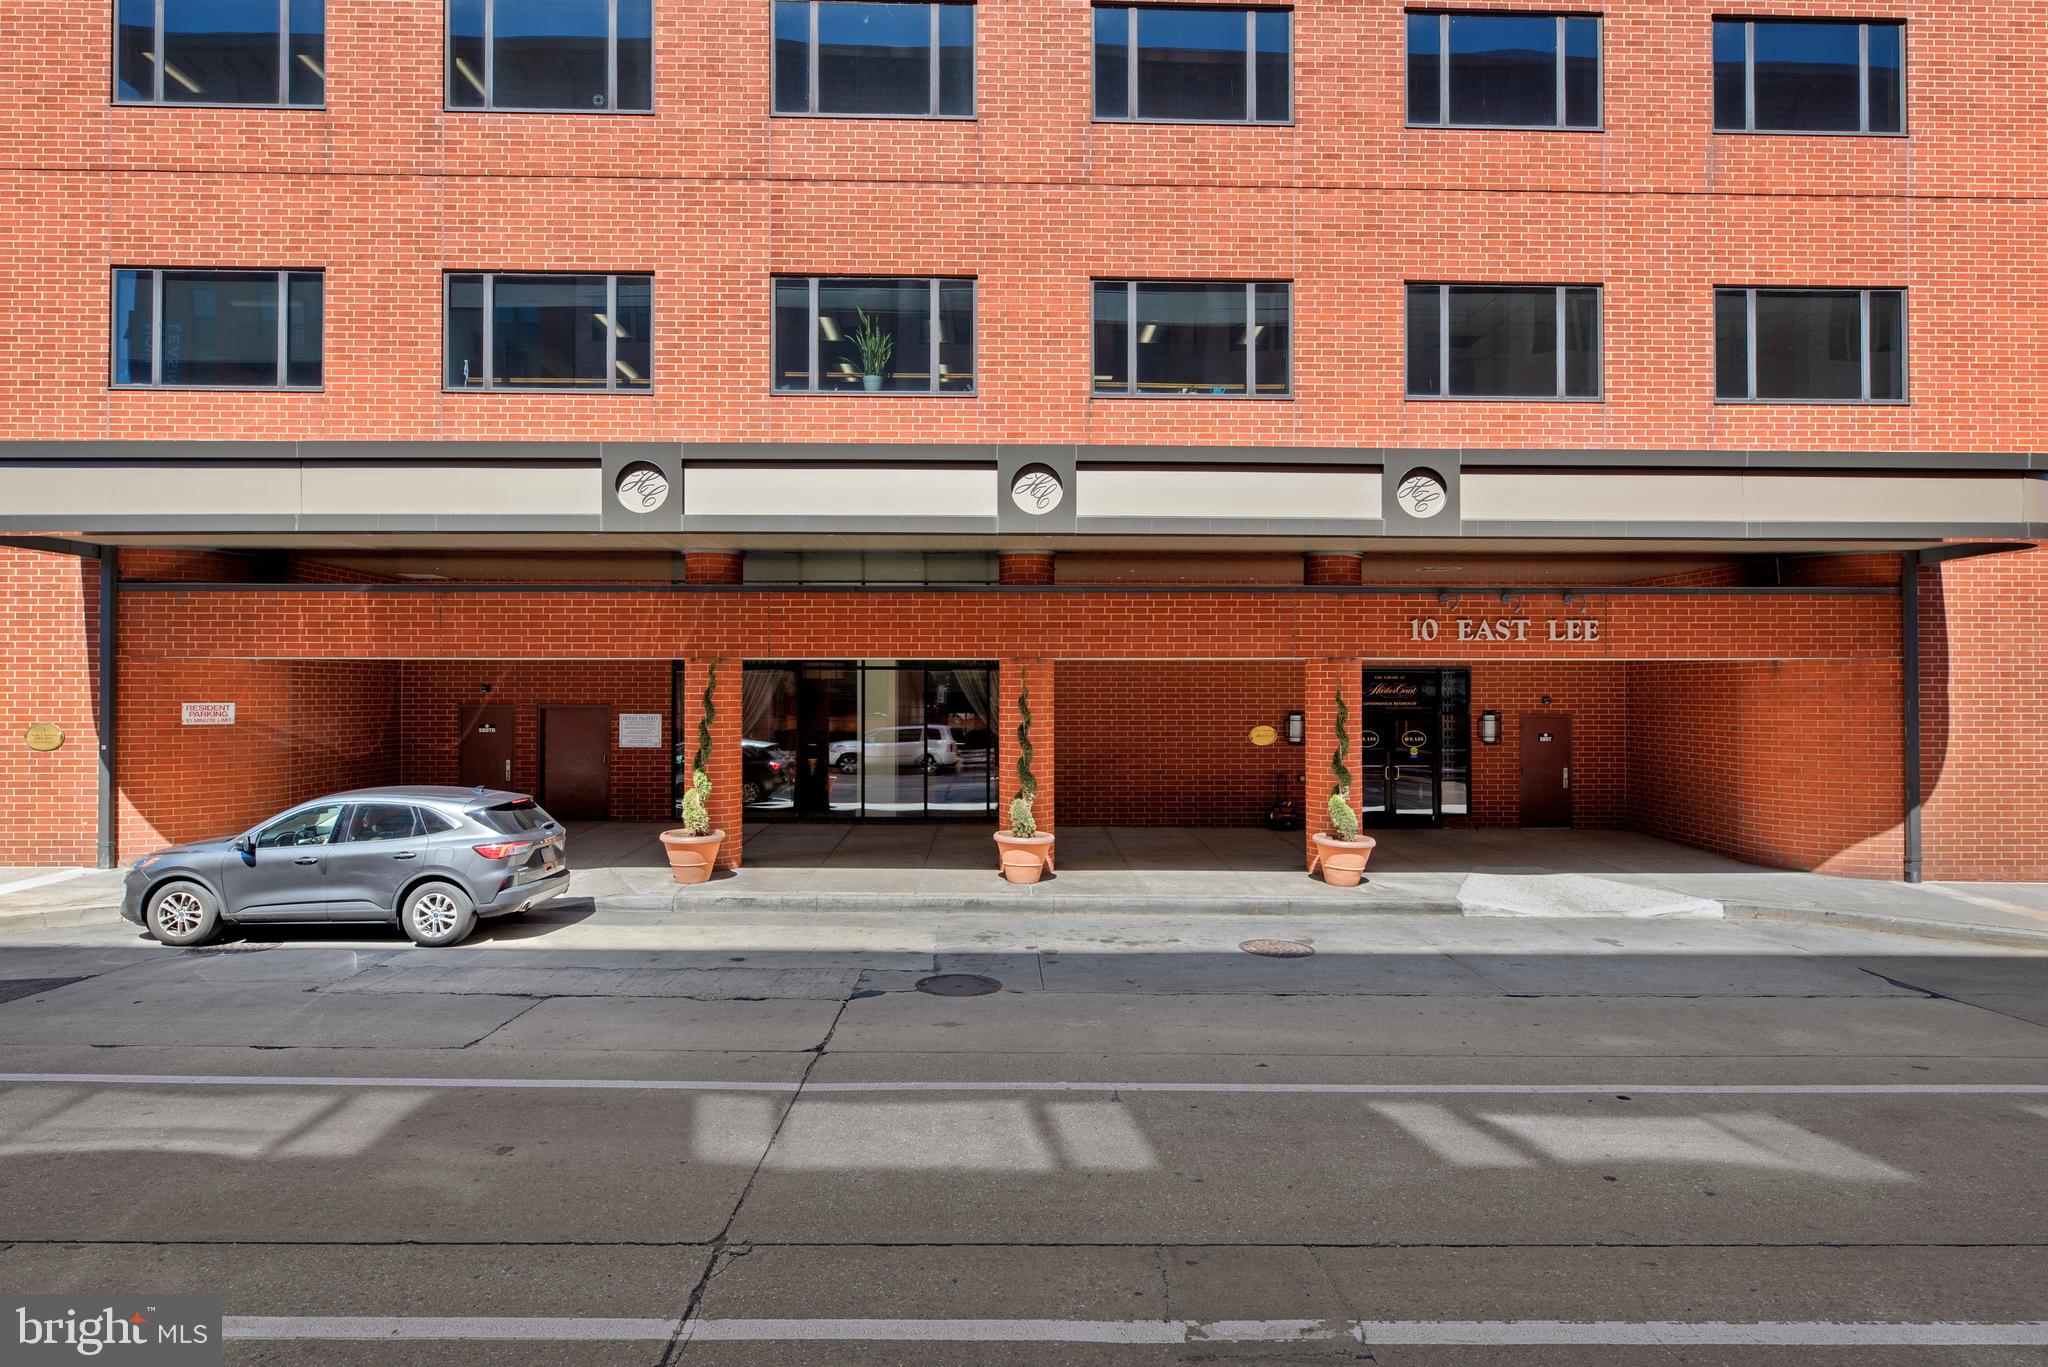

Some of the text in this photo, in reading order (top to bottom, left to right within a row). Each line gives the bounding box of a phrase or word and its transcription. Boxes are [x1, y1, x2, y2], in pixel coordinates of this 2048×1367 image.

[1410, 619, 1600, 641] 10 EAST LEE
